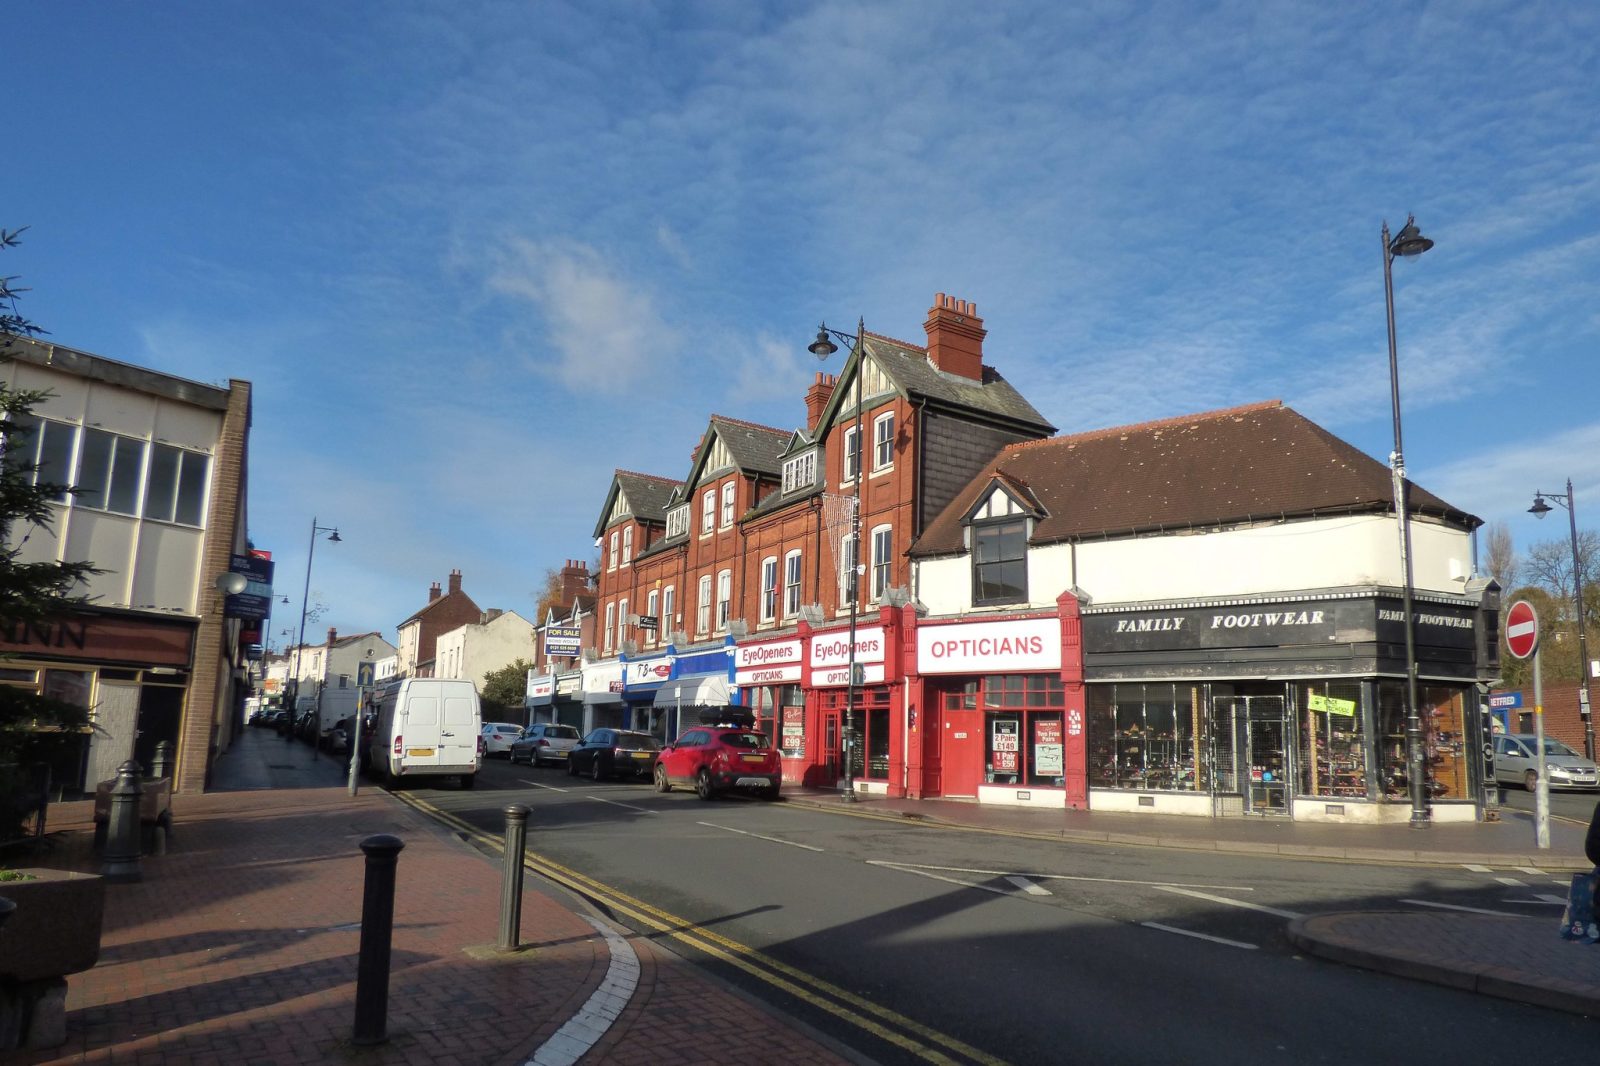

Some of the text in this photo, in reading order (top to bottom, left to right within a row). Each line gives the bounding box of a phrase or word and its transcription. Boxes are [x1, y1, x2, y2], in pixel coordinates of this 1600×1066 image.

[1117, 611, 1325, 632] FAMILY FOOTWEAR
[1419, 613, 1473, 628] FOOTWEAR
[815, 639, 879, 661] EyeOpners
[931, 636, 1043, 658] OPTICIANS
[742, 646, 793, 665] EyeOpeners
[752, 670, 783, 682] OPTICIANS
[785, 738, 801, 747] £99
[1001, 734, 1016, 742] Pairs
[997, 742, 1015, 751] £149
[996, 752, 1016, 760] 1 Pair
[1002, 760, 1016, 768] £50
